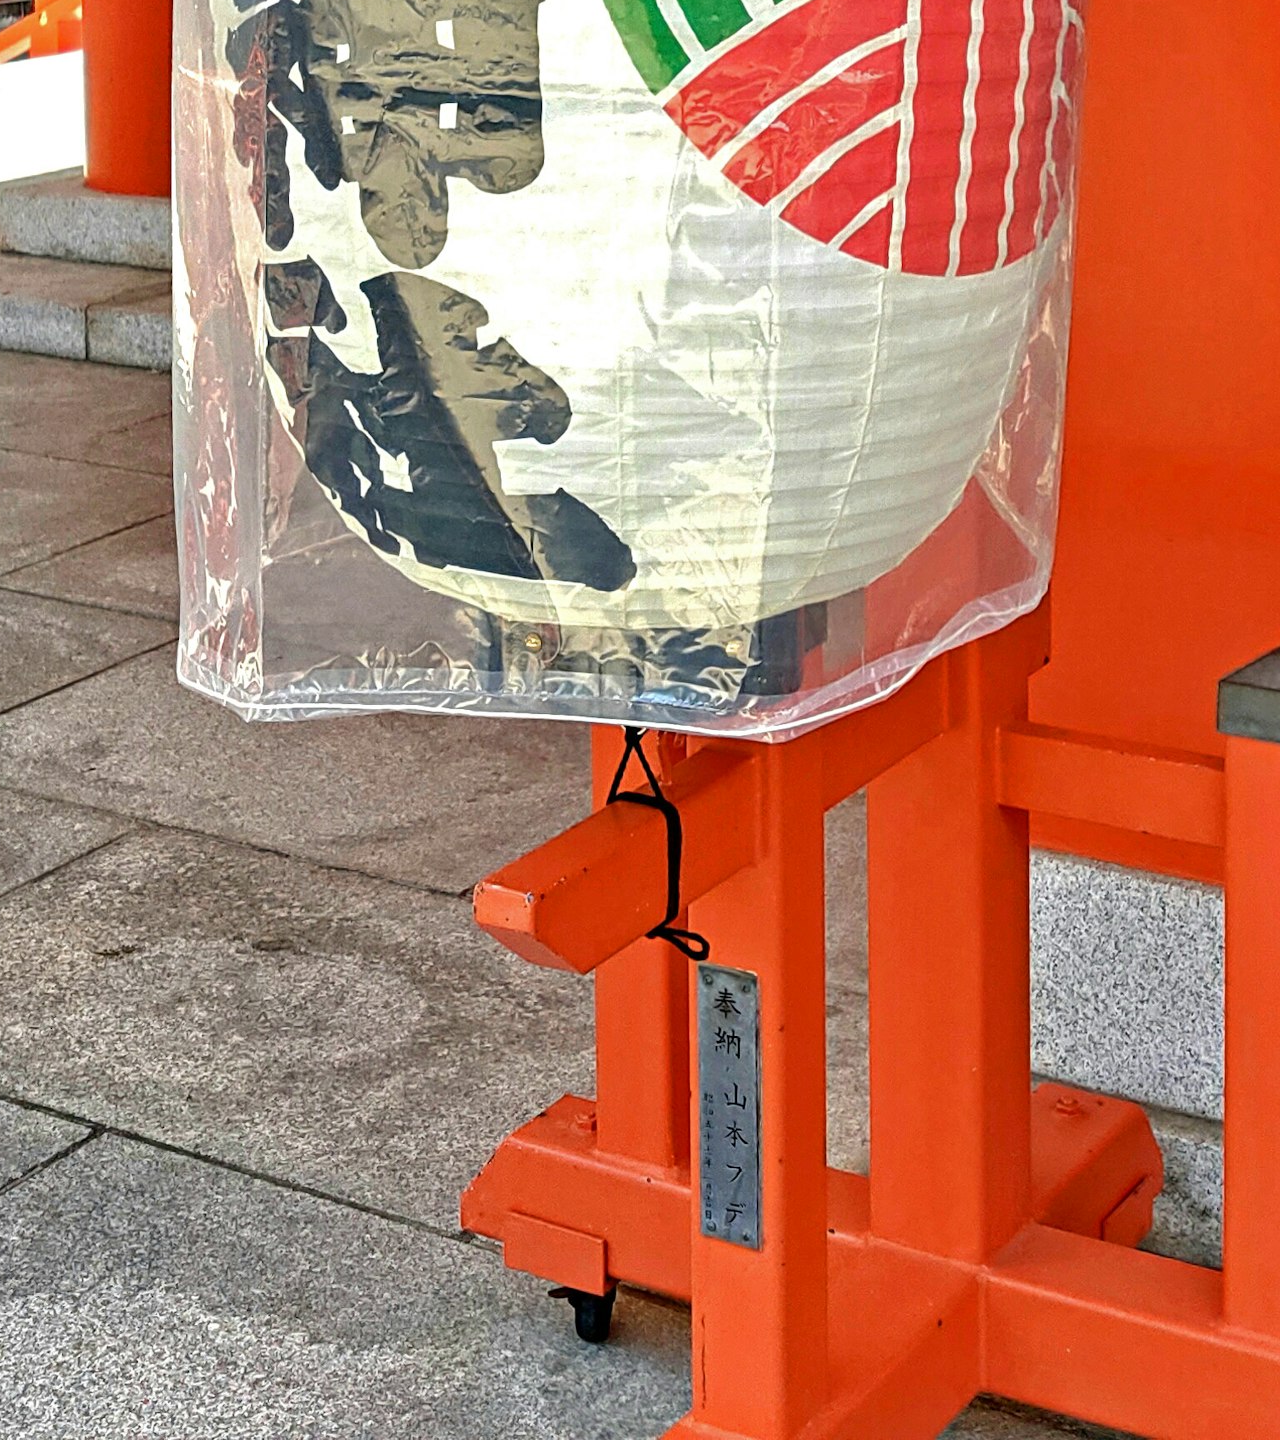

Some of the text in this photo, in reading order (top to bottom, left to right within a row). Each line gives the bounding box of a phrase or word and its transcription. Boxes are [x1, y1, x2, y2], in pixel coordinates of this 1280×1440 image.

[713, 988, 749, 1225] 奉納 山本フデ
